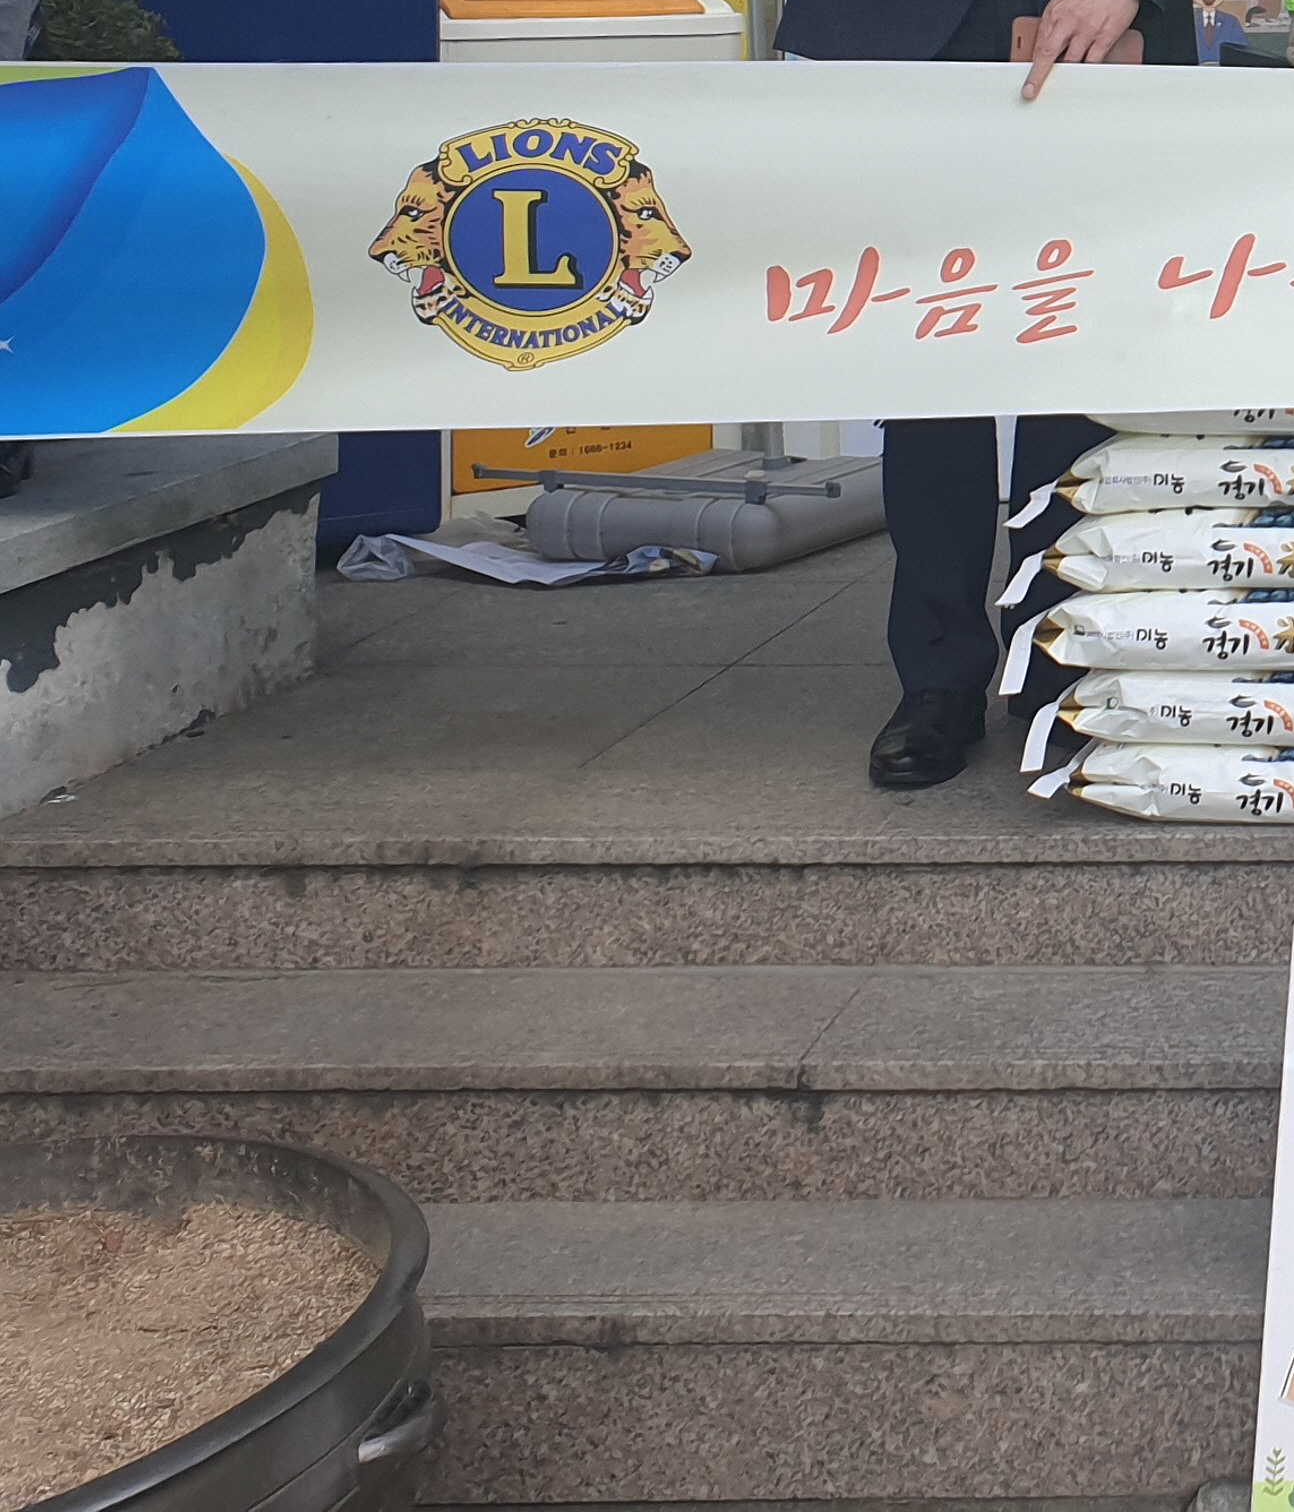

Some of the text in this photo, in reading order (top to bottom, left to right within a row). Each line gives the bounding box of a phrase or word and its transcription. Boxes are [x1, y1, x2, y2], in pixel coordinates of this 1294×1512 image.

[457, 129, 623, 176] LIONS
[493, 189, 584, 290] L
[764, 237, 1094, 345] 마음을
[440, 296, 634, 349] INTERNATIONAL
[1154, 473, 1185, 494] 미농
[1218, 475, 1265, 500] 경기
[1142, 551, 1174, 573] 미농
[1207, 554, 1254, 581] 경기
[1136, 628, 1169, 650] 미농
[1202, 630, 1250, 660] 경기
[1160, 705, 1192, 728] 미농
[1226, 711, 1274, 738] 경기
[1170, 782, 1202, 805] 미농
[1235, 789, 1284, 816] 경기
